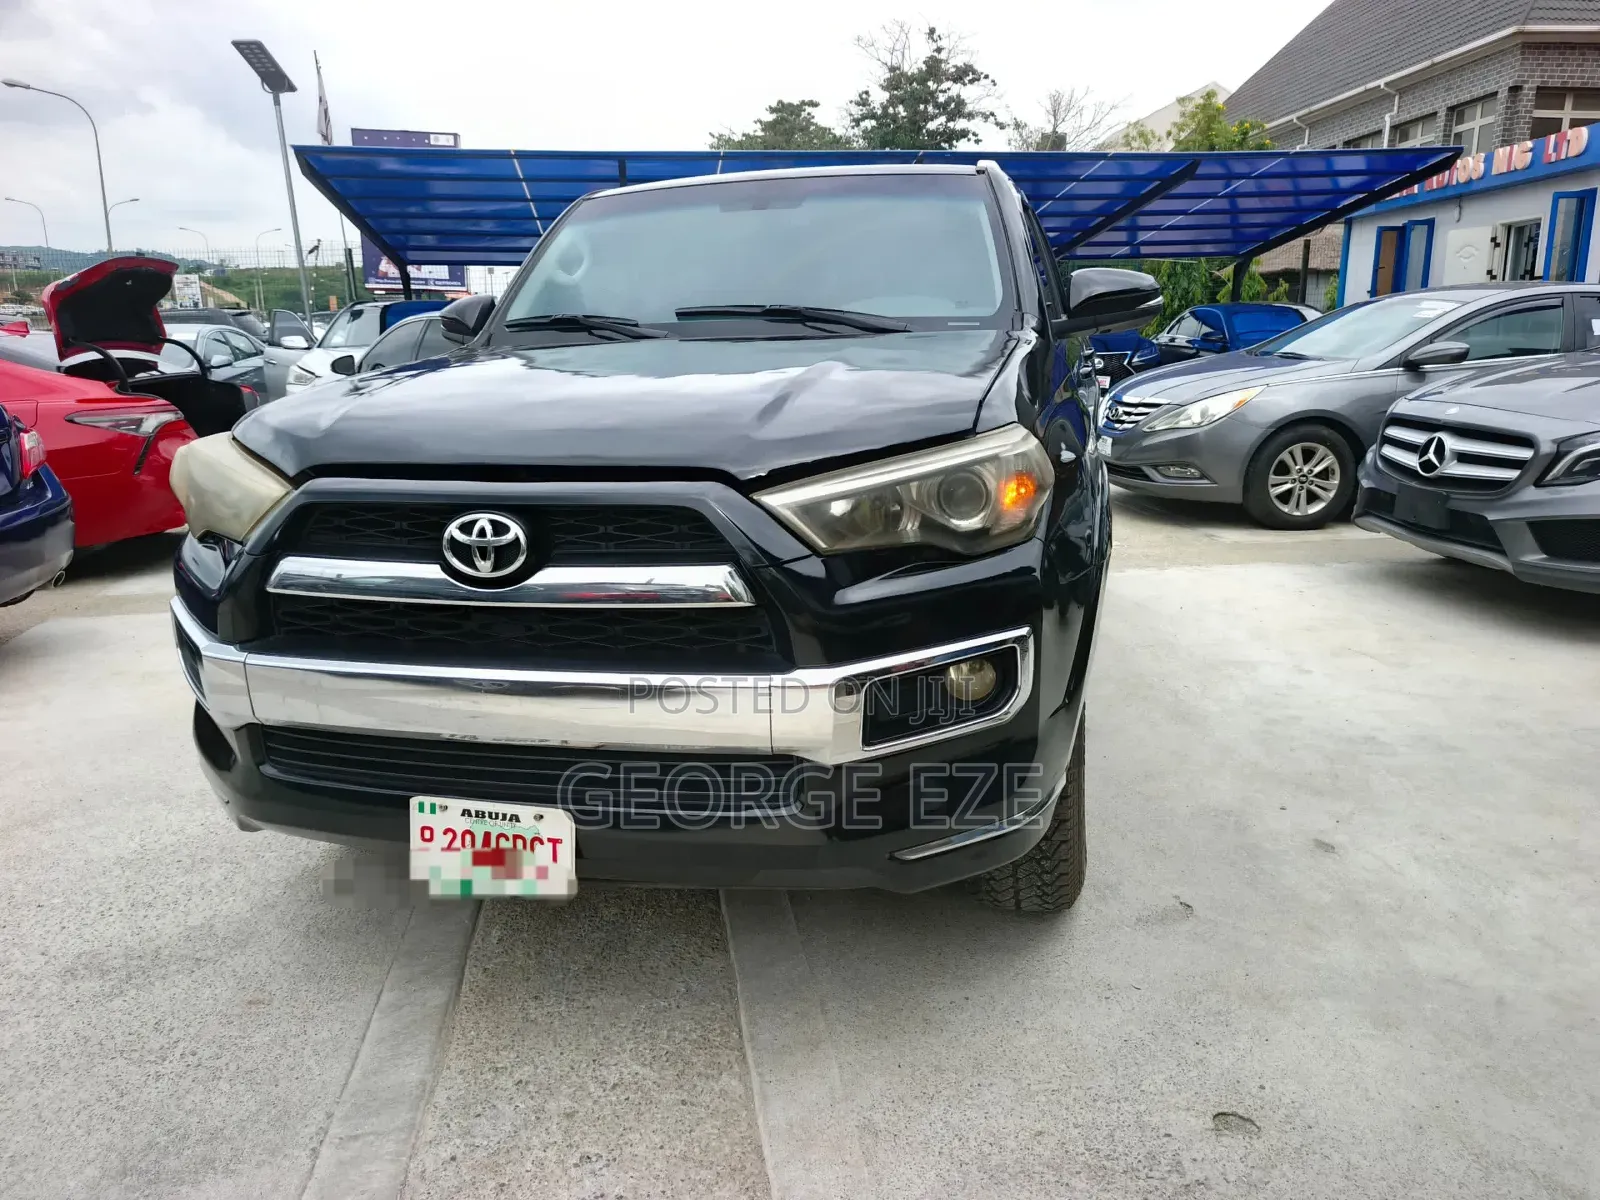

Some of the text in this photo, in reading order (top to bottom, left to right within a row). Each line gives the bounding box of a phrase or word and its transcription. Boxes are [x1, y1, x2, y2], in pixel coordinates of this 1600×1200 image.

[1491, 140, 1534, 176] NIG
[1542, 126, 1589, 165] LTD
[460, 808, 522, 824] ABUJA
